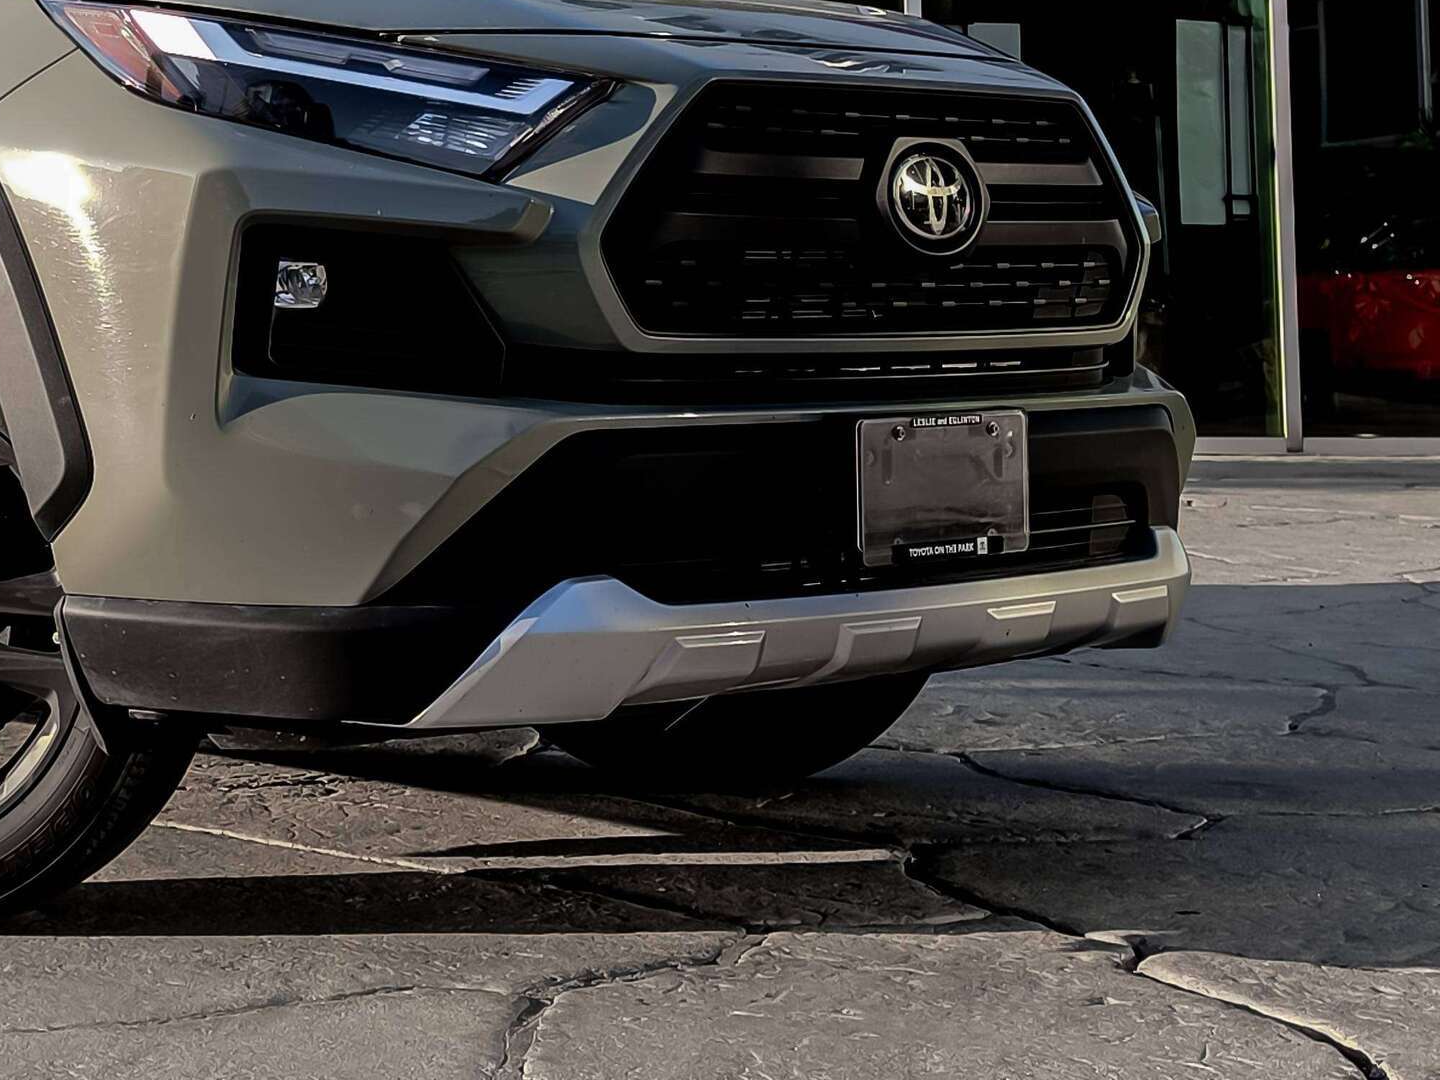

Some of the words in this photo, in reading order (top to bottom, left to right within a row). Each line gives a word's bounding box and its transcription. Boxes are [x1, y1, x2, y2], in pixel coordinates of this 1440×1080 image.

[913, 417, 936, 427] LESLIE
[909, 546, 934, 557] TOYOTA
[934, 545, 945, 555] ON
[945, 544, 957, 553] THE
[957, 542, 974, 552] PARK
